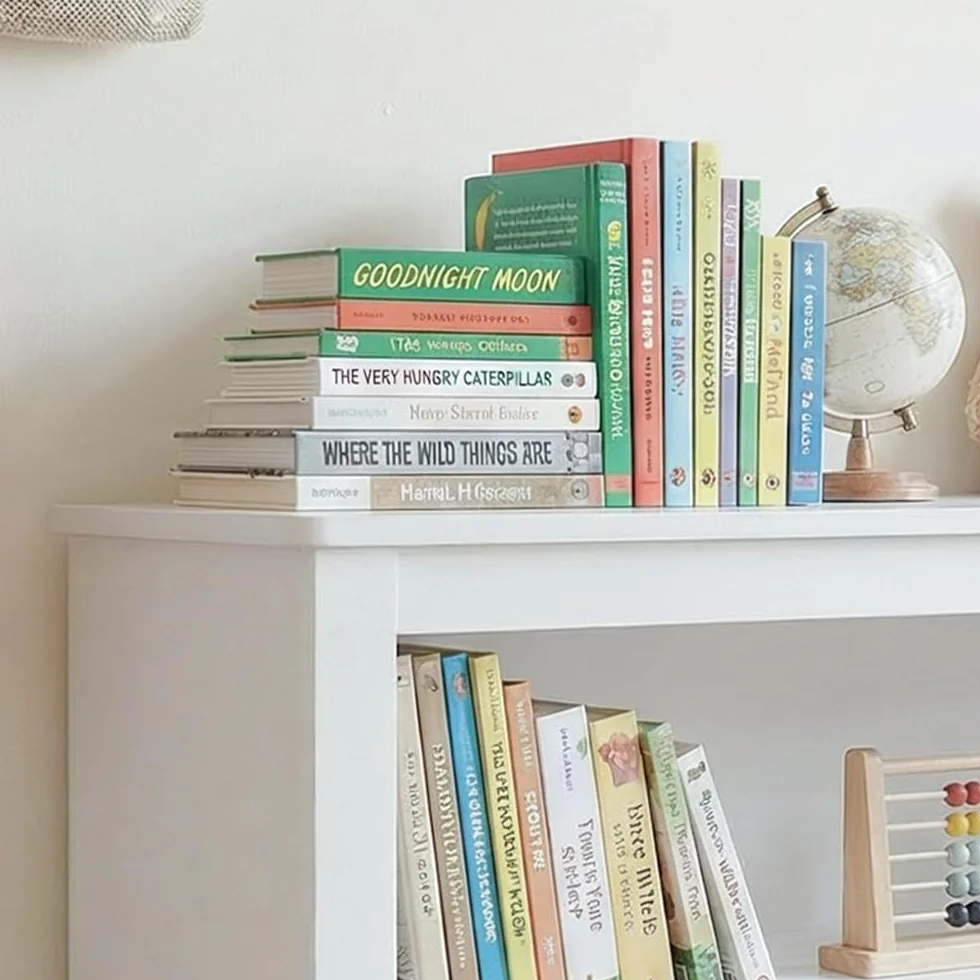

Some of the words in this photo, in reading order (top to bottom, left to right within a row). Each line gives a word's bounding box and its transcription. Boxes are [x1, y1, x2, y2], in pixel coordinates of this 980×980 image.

[353, 262, 490, 290] GOODNIGHT
[492, 267, 561, 293] MOON
[332, 368, 360, 385] THE
[363, 369, 400, 386] VERY
[403, 369, 460, 386] HUNGRY
[322, 440, 379, 466] WHERE
[382, 440, 412, 466] THE
[417, 440, 456, 466] WILD
[460, 440, 518, 466] THINGS
[522, 440, 553, 466] ARE
